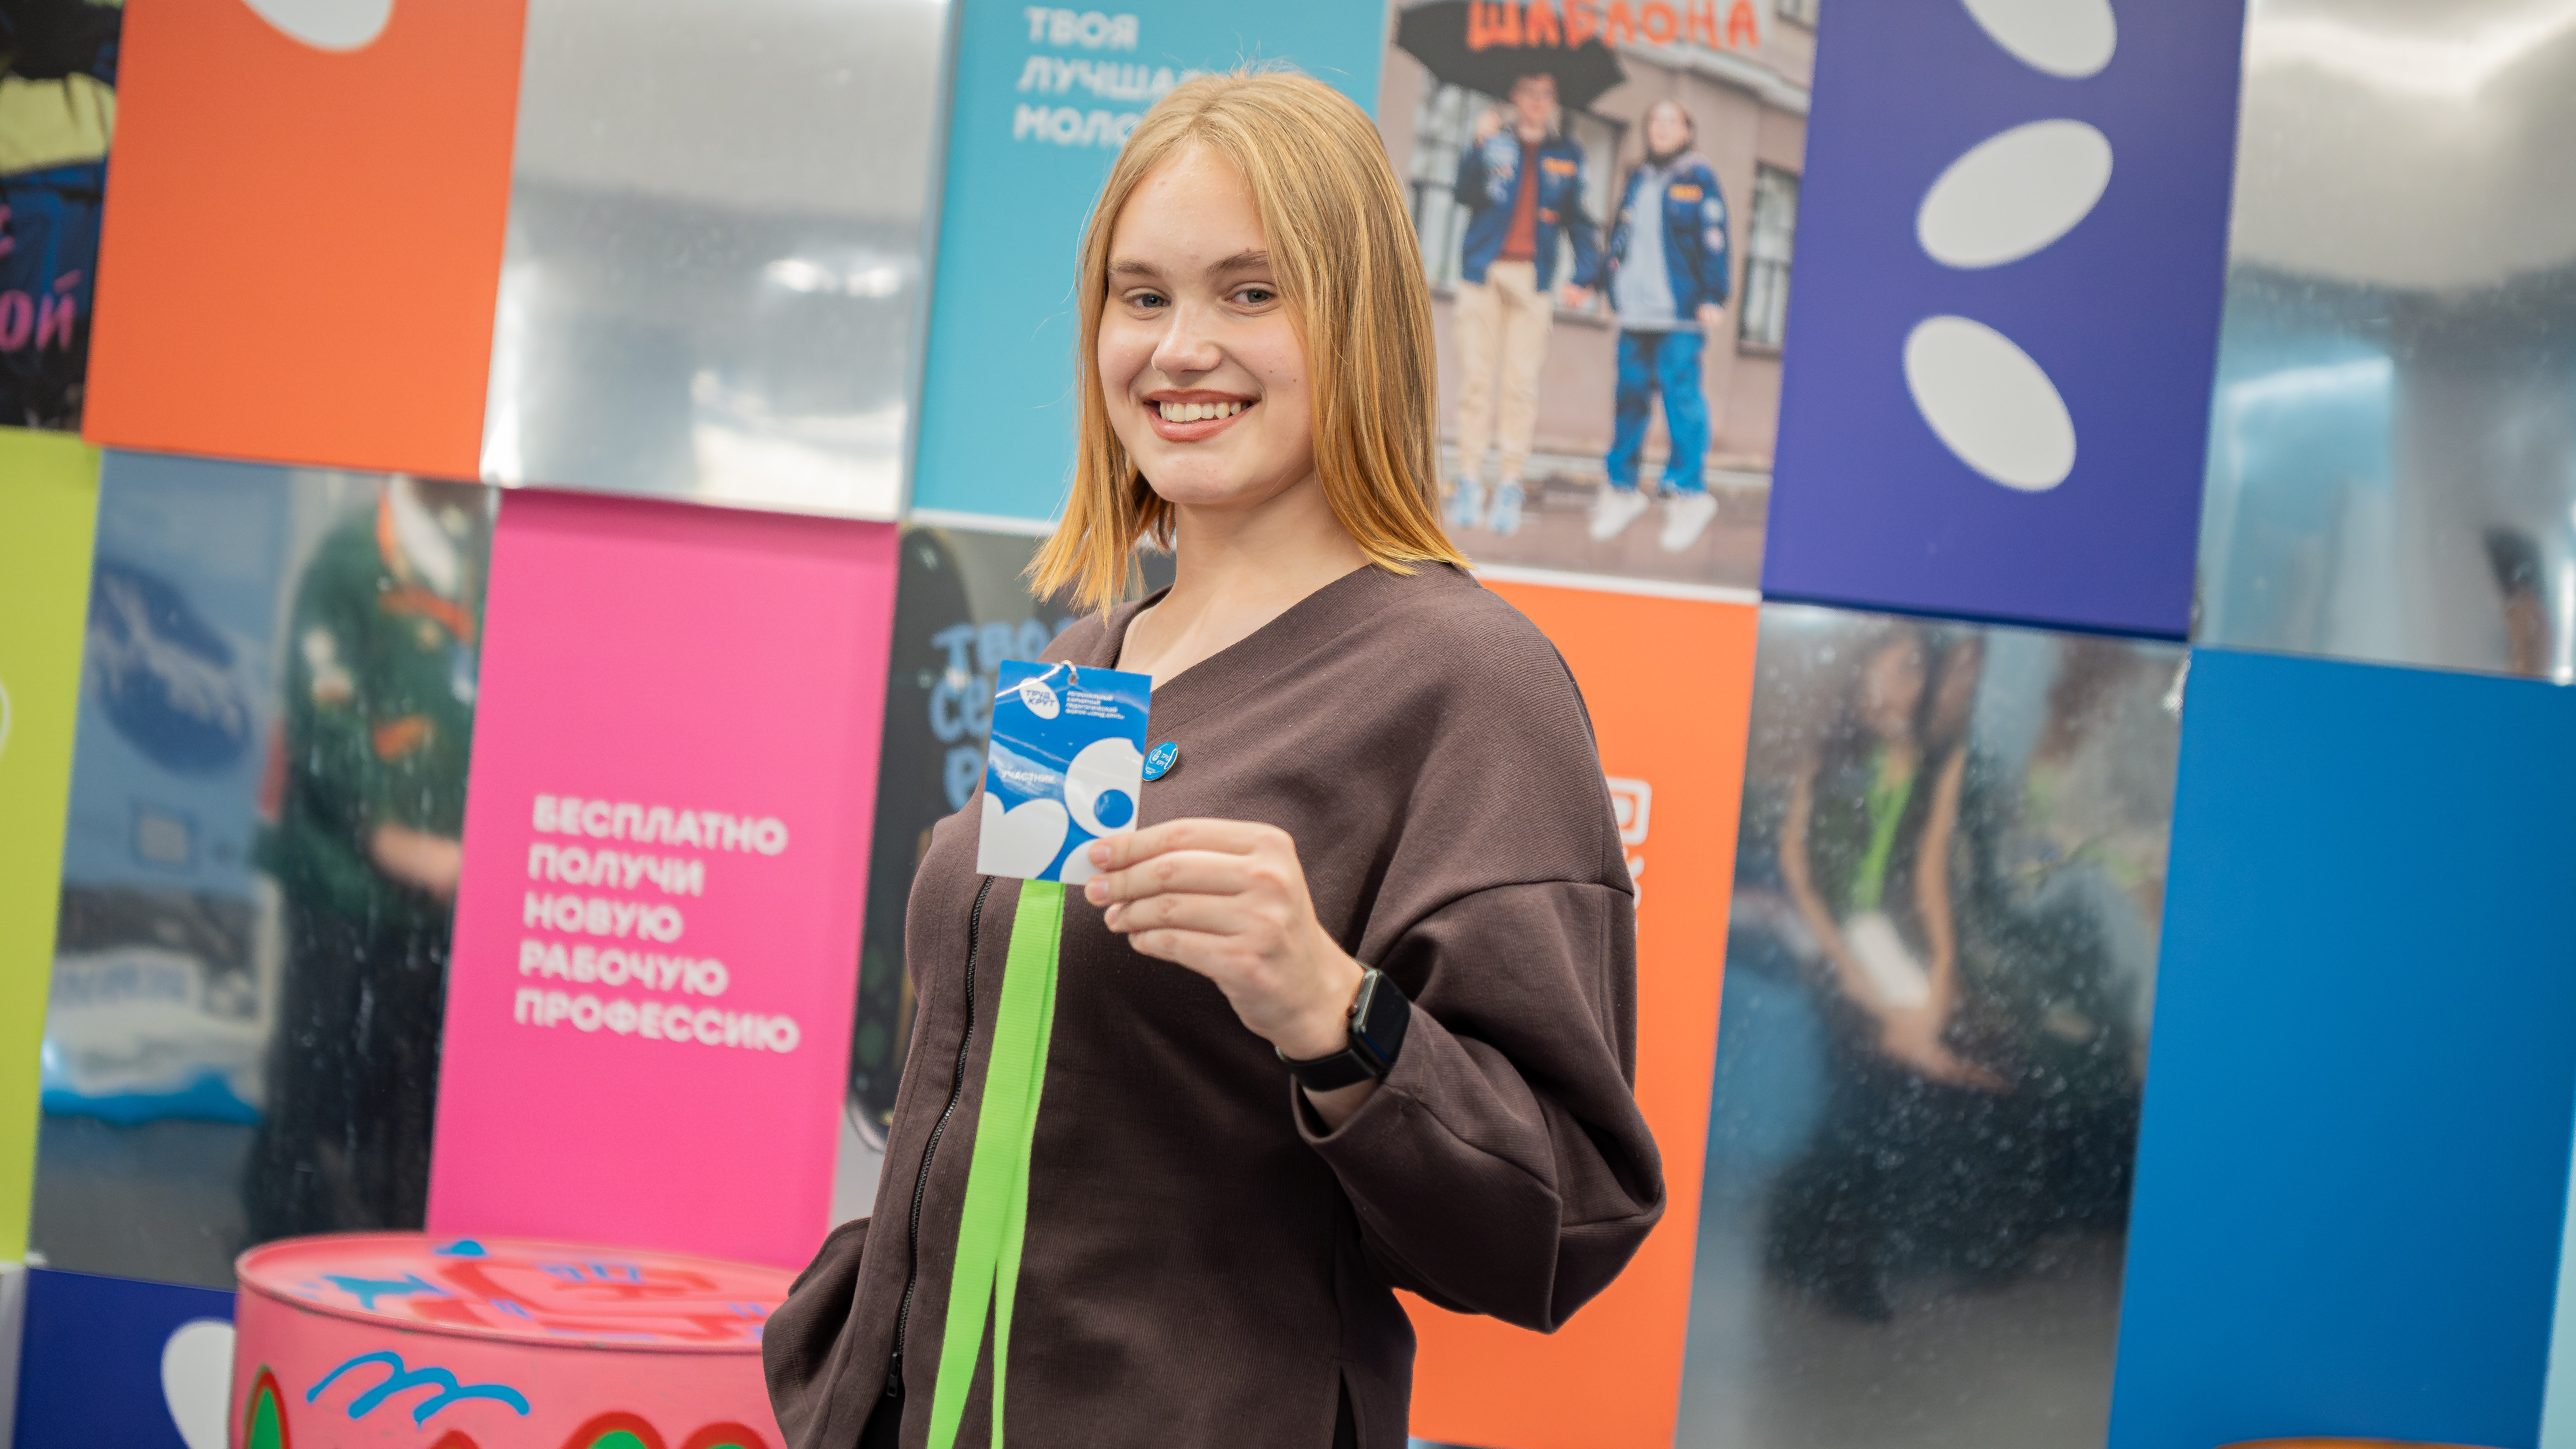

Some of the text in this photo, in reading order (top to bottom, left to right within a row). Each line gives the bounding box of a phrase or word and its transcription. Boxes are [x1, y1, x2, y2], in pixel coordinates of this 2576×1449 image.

[1026, 6, 1139, 51] ТВОЯ
[1466, 0, 1759, 52] ШАБЛОНА
[1017, 55, 1203, 101] ЛУЧША
[1026, 690, 1051, 699] ТРУД
[1028, 698, 1055, 707] КРУТ
[533, 794, 789, 856] БЕСПЛАТНО
[528, 842, 705, 896] ПОЛУЧИ
[523, 892, 684, 943] НОВУЮ
[519, 939, 729, 996] РАБОЧУЮ
[514, 988, 800, 1053] ПРОФЕССИЮ
